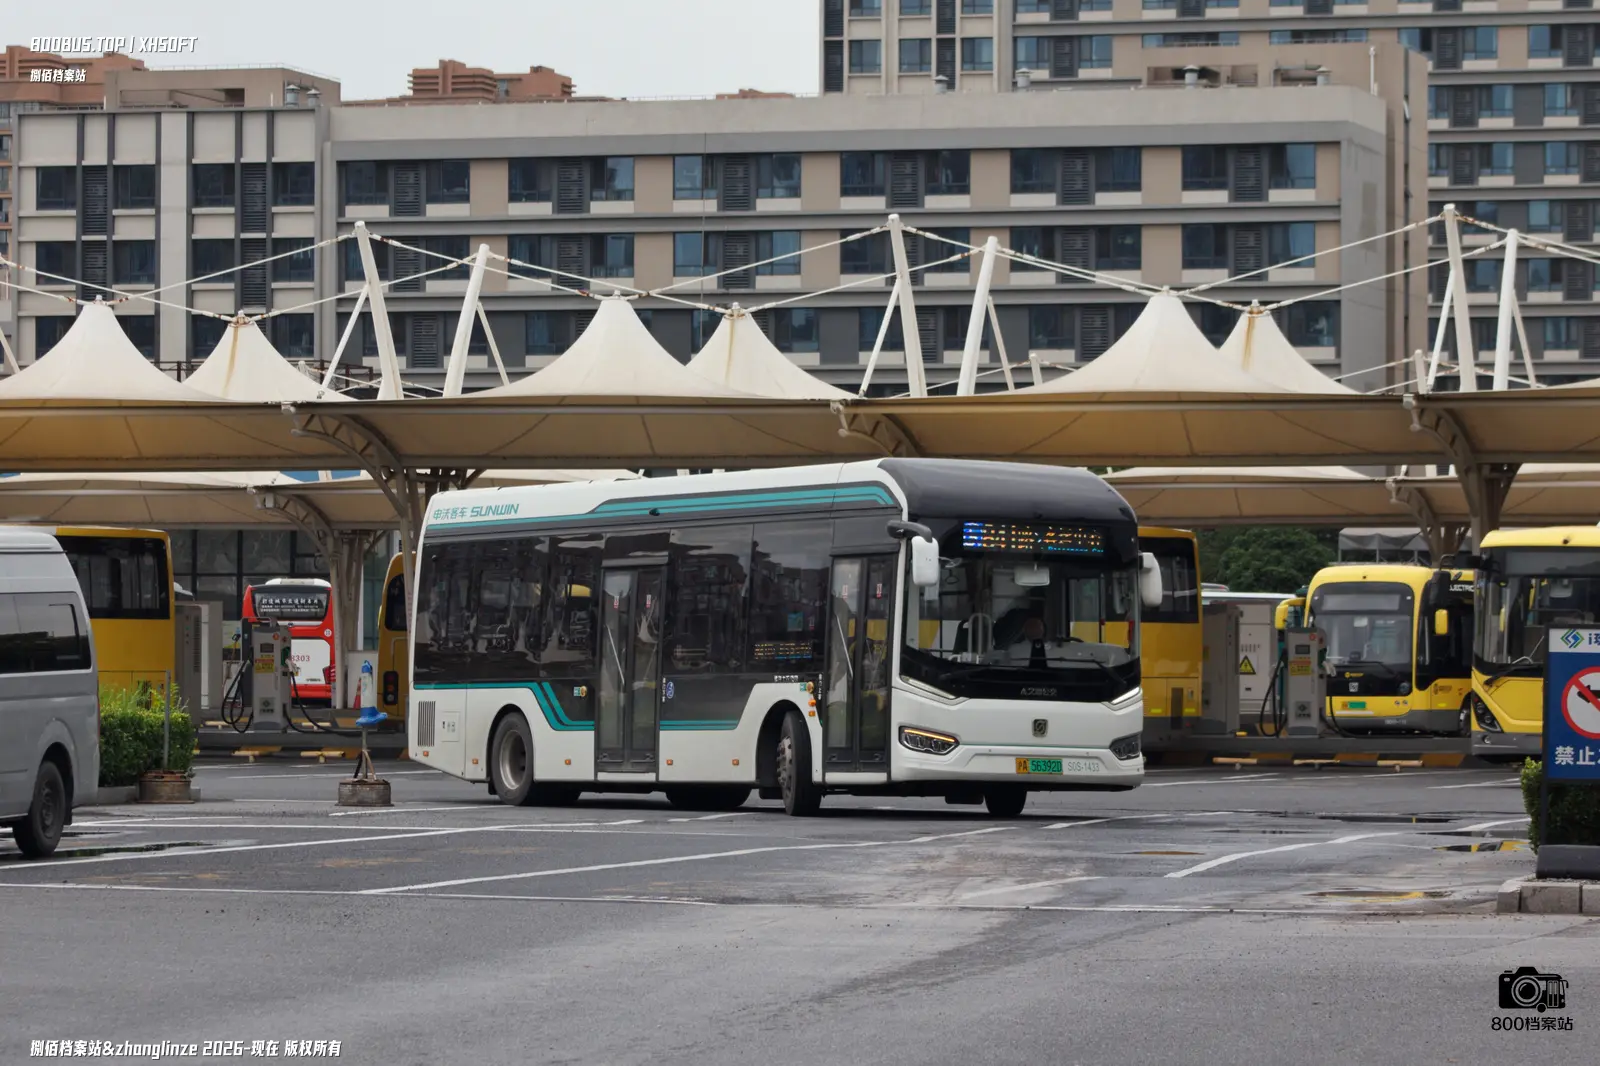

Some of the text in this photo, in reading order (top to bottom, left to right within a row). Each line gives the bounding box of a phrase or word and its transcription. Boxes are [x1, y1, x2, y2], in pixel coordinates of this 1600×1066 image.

[433, 504, 520, 520] 申沃客车 SUNWIN
[1555, 745, 1600, 766] 禁止
